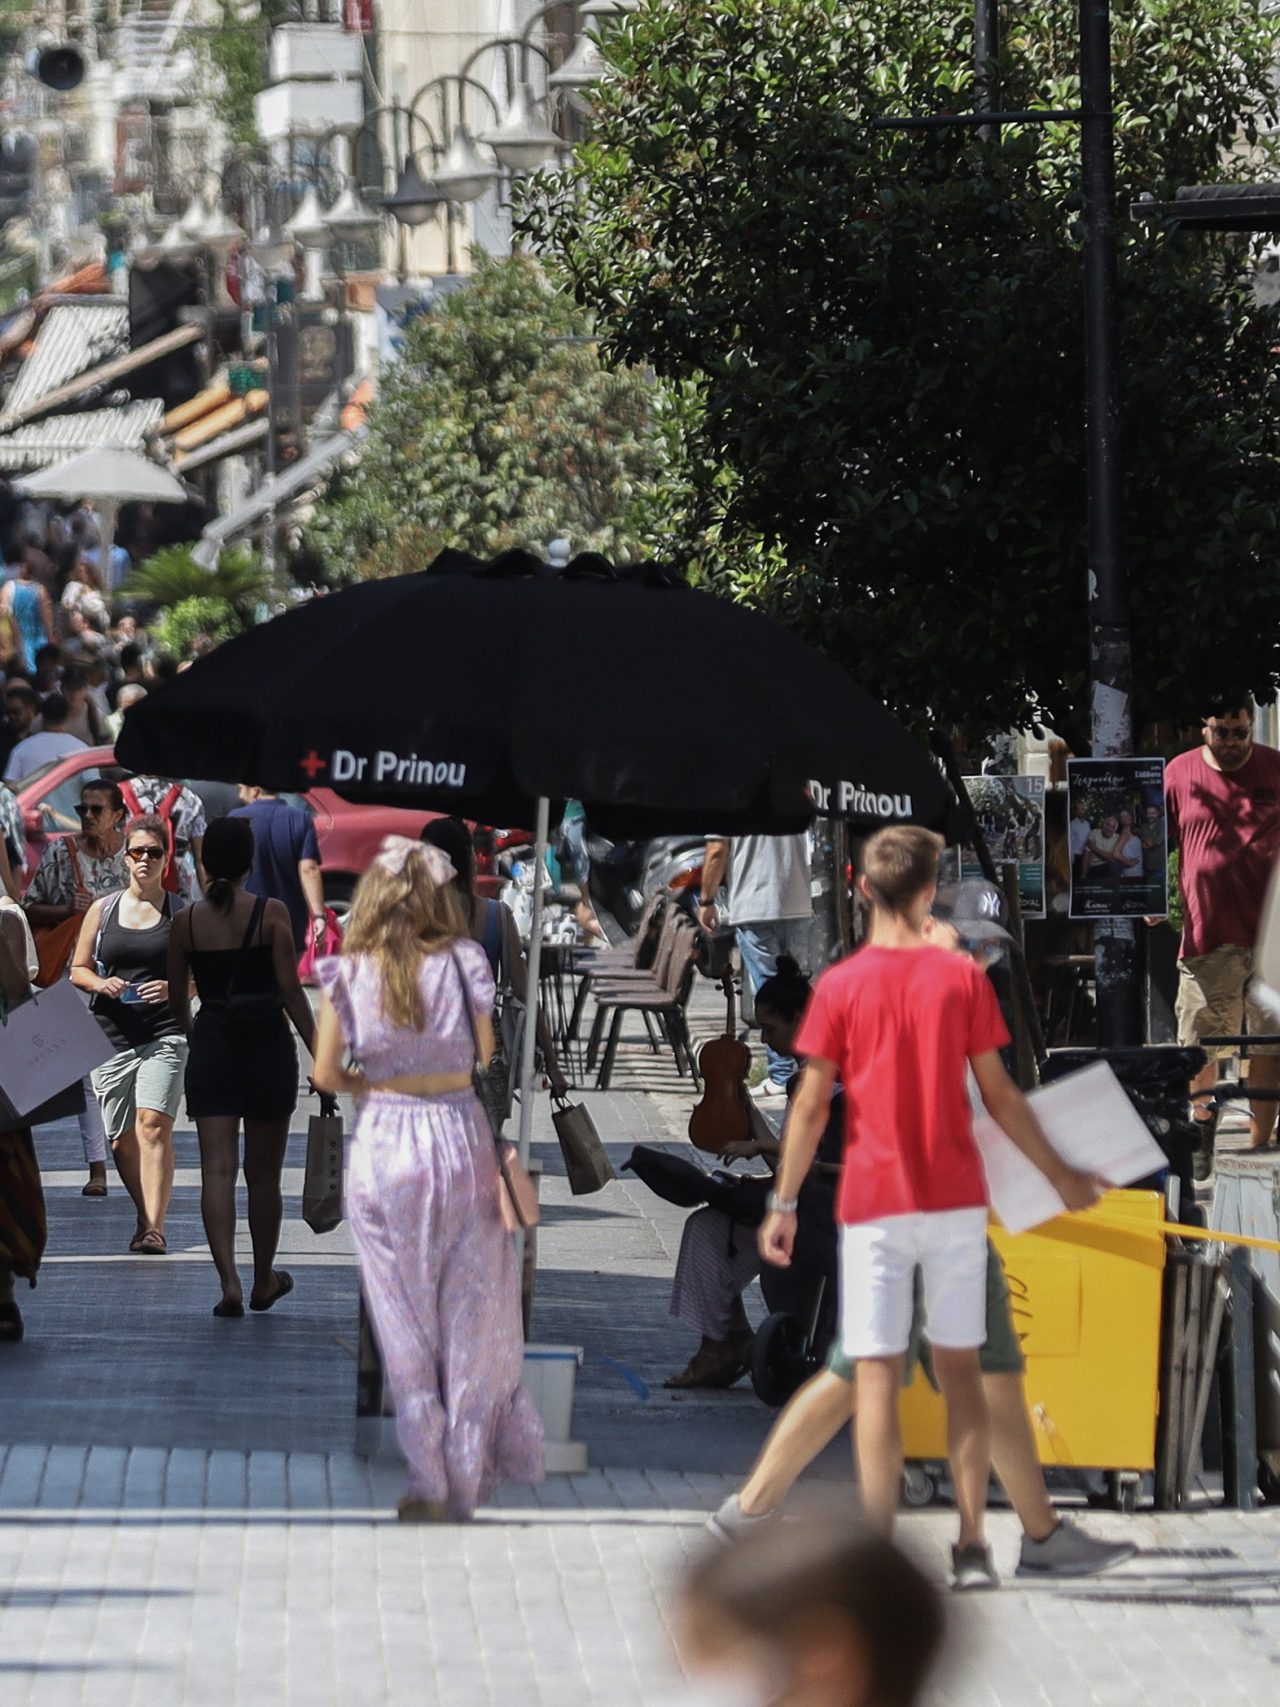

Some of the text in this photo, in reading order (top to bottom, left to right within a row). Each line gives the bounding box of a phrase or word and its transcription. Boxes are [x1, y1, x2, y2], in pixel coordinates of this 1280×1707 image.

[333, 750, 466, 787] Dr Prinou
[808, 779, 913, 818] Dr Prinou
[1025, 777, 1043, 793] 15
[982, 891, 1001, 917] NY
